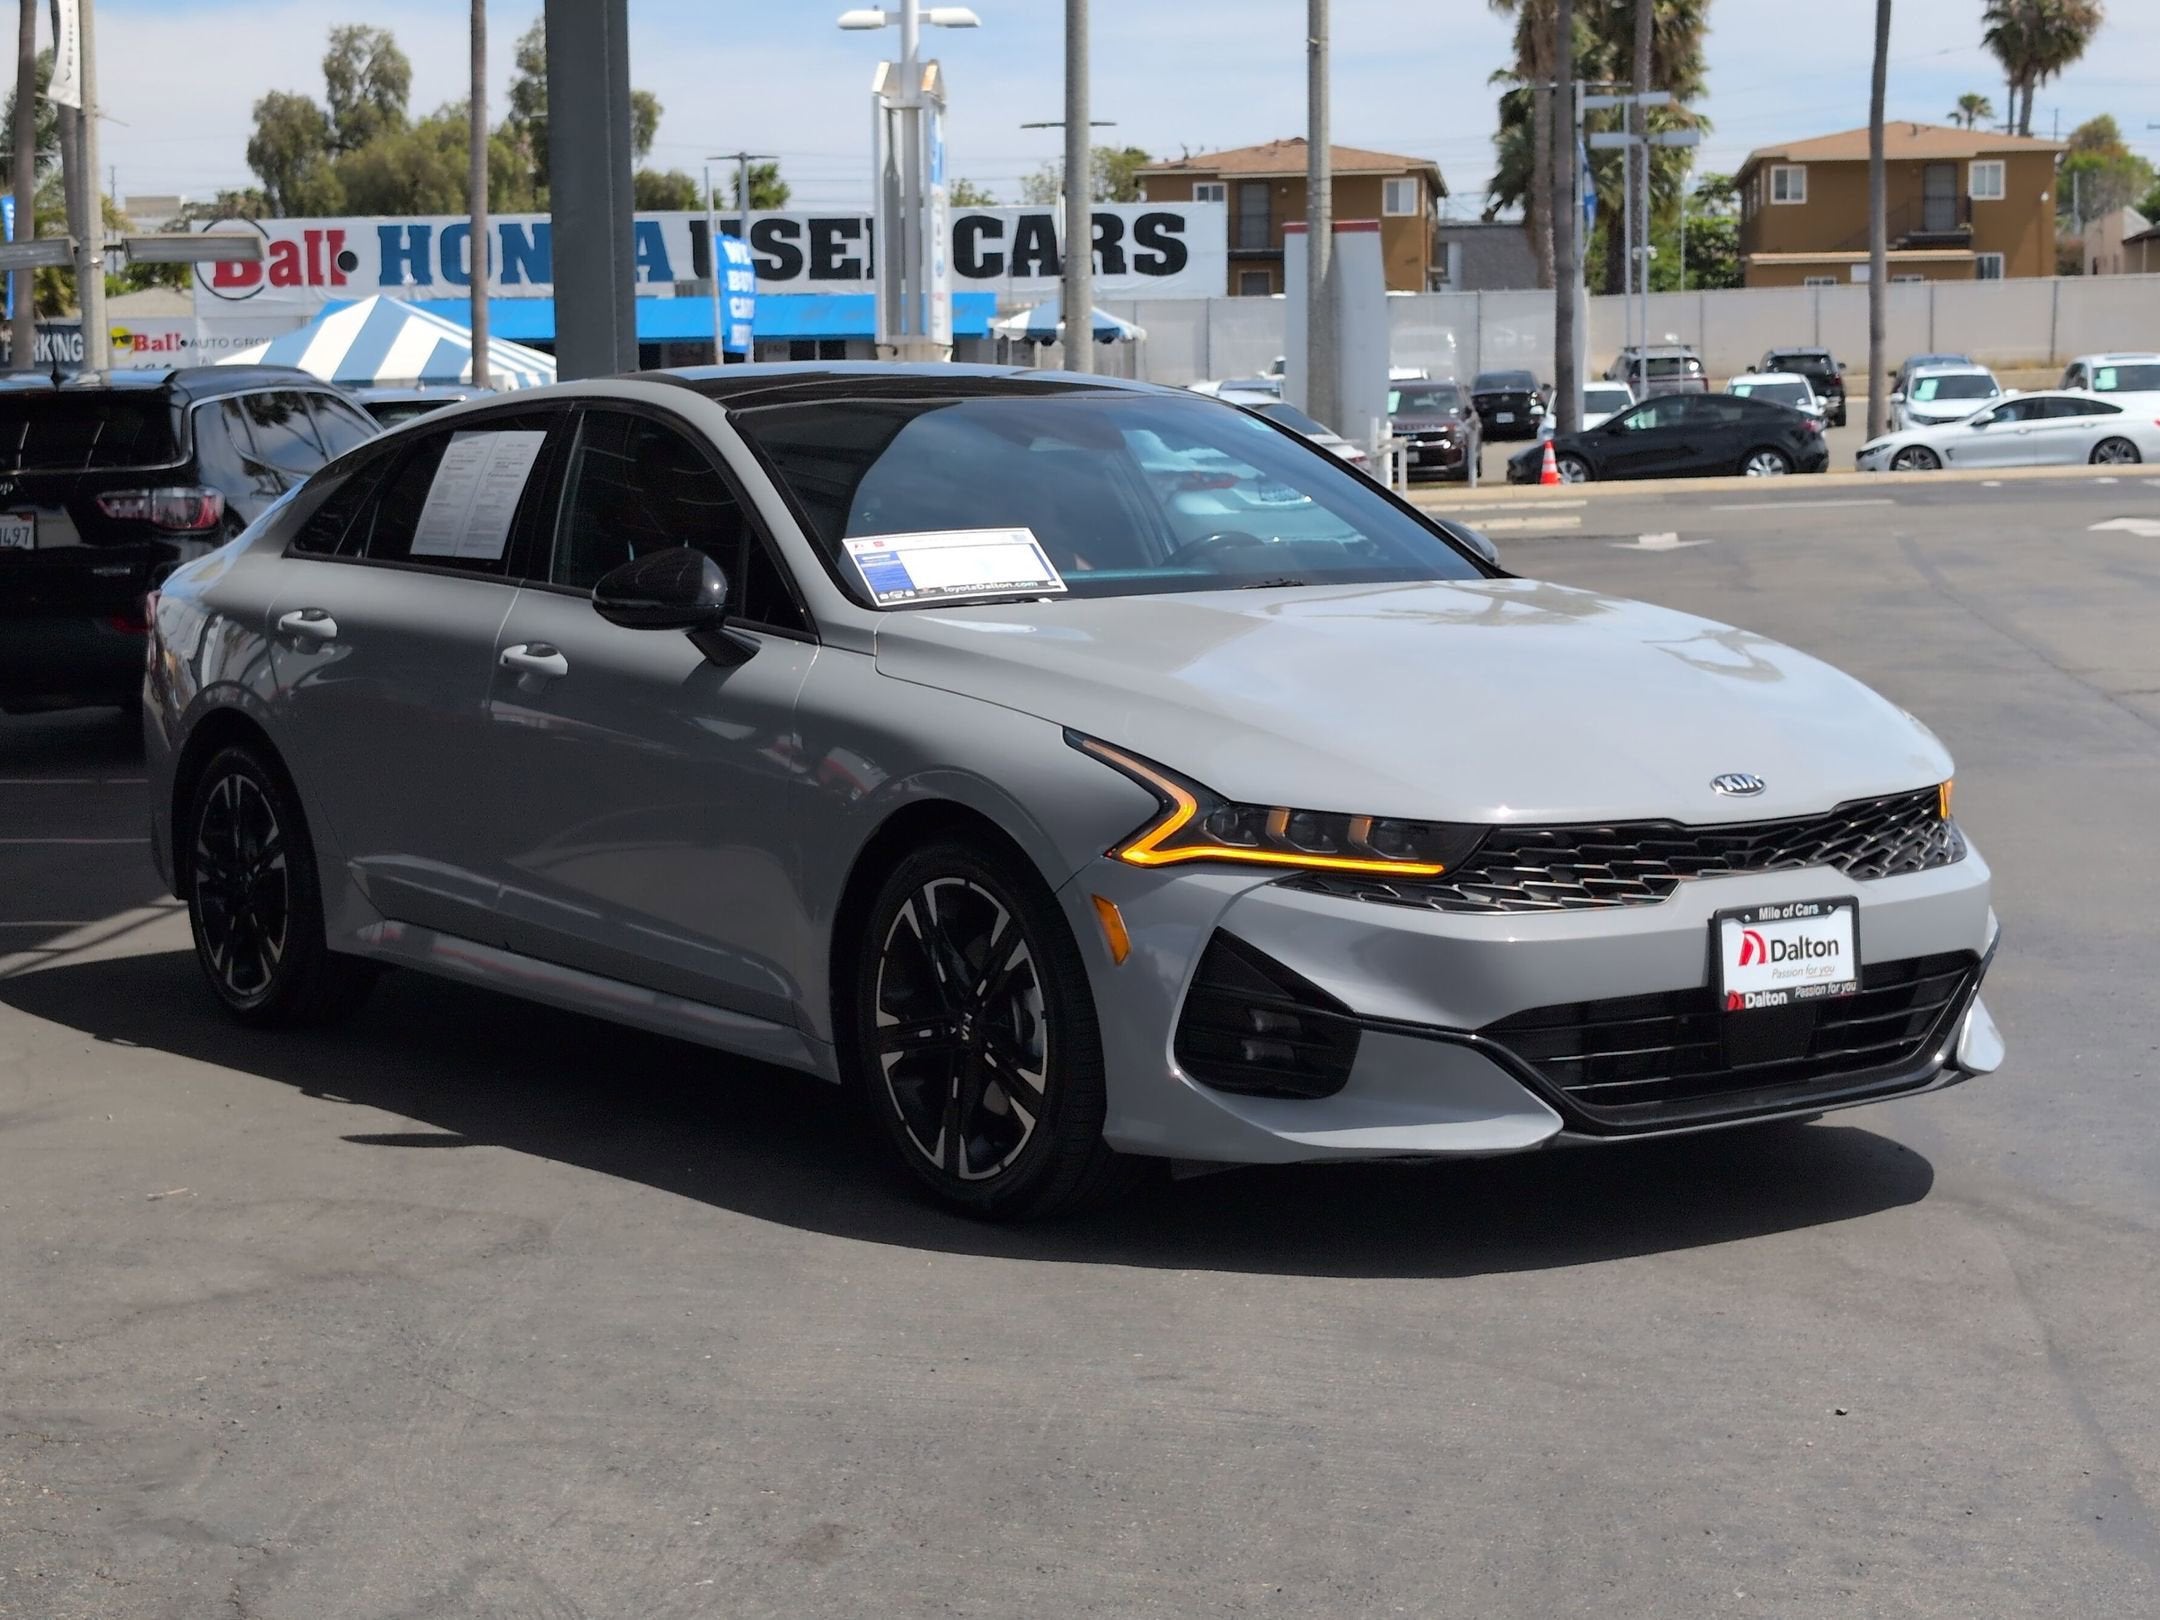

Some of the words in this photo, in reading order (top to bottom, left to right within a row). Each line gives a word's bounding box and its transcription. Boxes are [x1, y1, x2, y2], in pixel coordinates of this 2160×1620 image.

[378, 222, 674, 286] HONA
[952, 212, 1188, 279] CARS
[133, 332, 181, 352] Ball
[189, 337, 229, 349] AUTO
[0, 526, 30, 546] 497
[1716, 774, 1763, 792] KIA
[1758, 906, 1780, 920] Mile
[1782, 907, 1794, 917] of
[1795, 903, 1819, 916] Cars
[1770, 935, 1839, 963] Dalton
[1772, 969, 1803, 979] Passion
[1805, 964, 1817, 976] for
[1818, 965, 1836, 977] you
[1745, 991, 1788, 1009] Dalton
[1794, 984, 1826, 998] Passion
[1827, 982, 1841, 995] for
[1841, 981, 1857, 994] you
